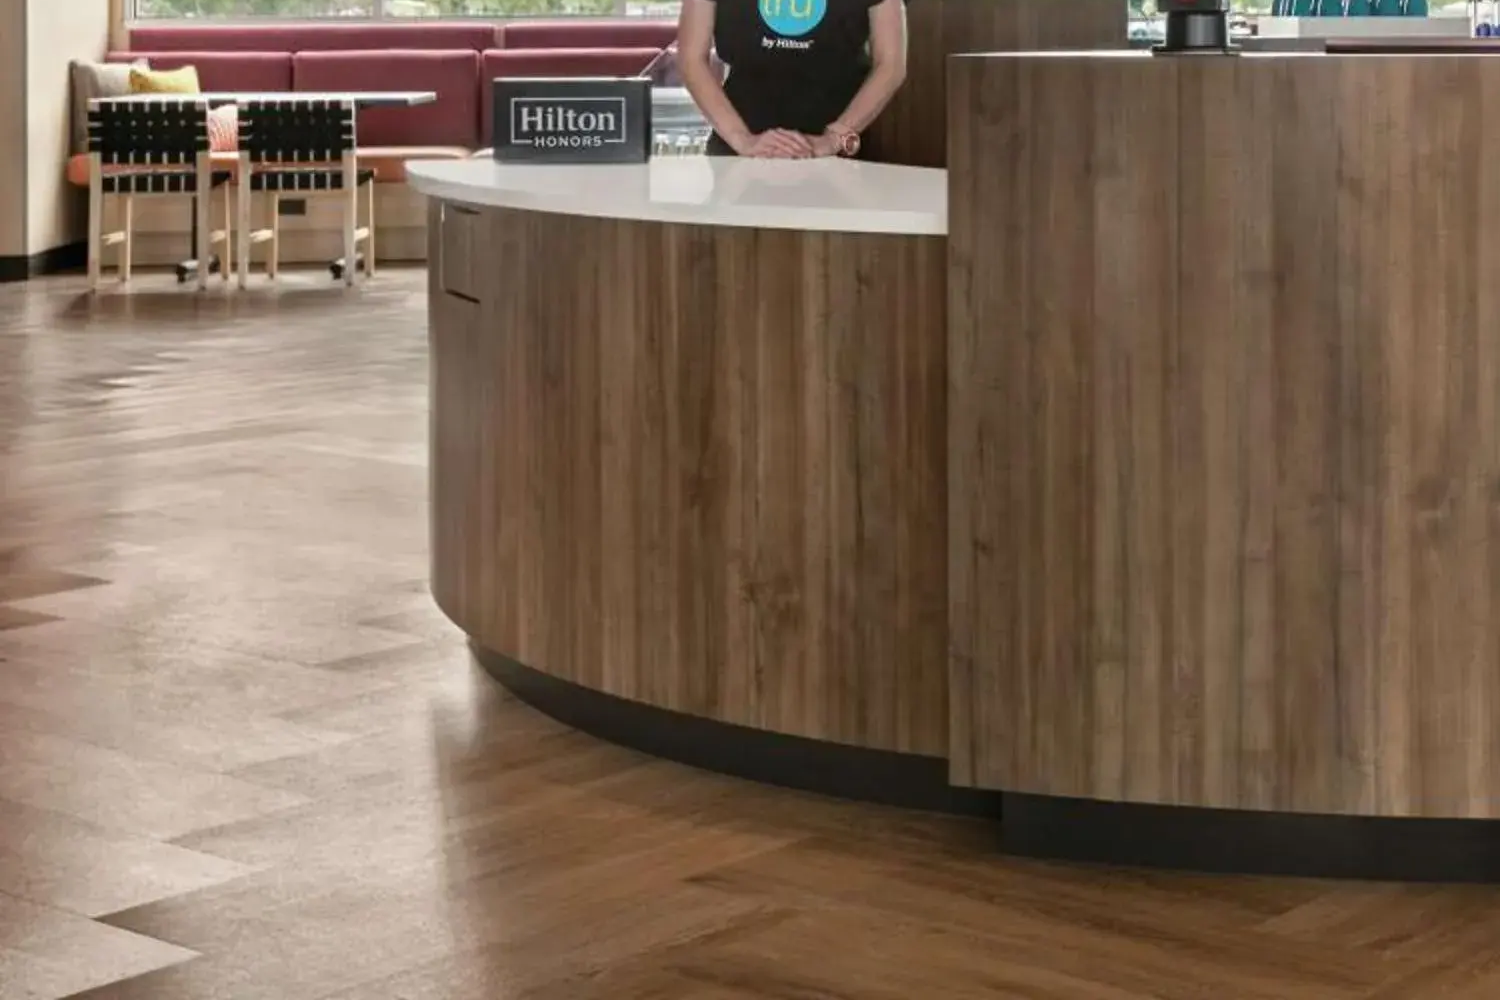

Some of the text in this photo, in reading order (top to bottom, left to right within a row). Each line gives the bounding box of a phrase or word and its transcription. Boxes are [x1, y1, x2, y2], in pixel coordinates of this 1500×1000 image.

[761, 36, 774, 49] by
[520, 105, 617, 133] Hilton
[534, 135, 602, 148] HONORS
